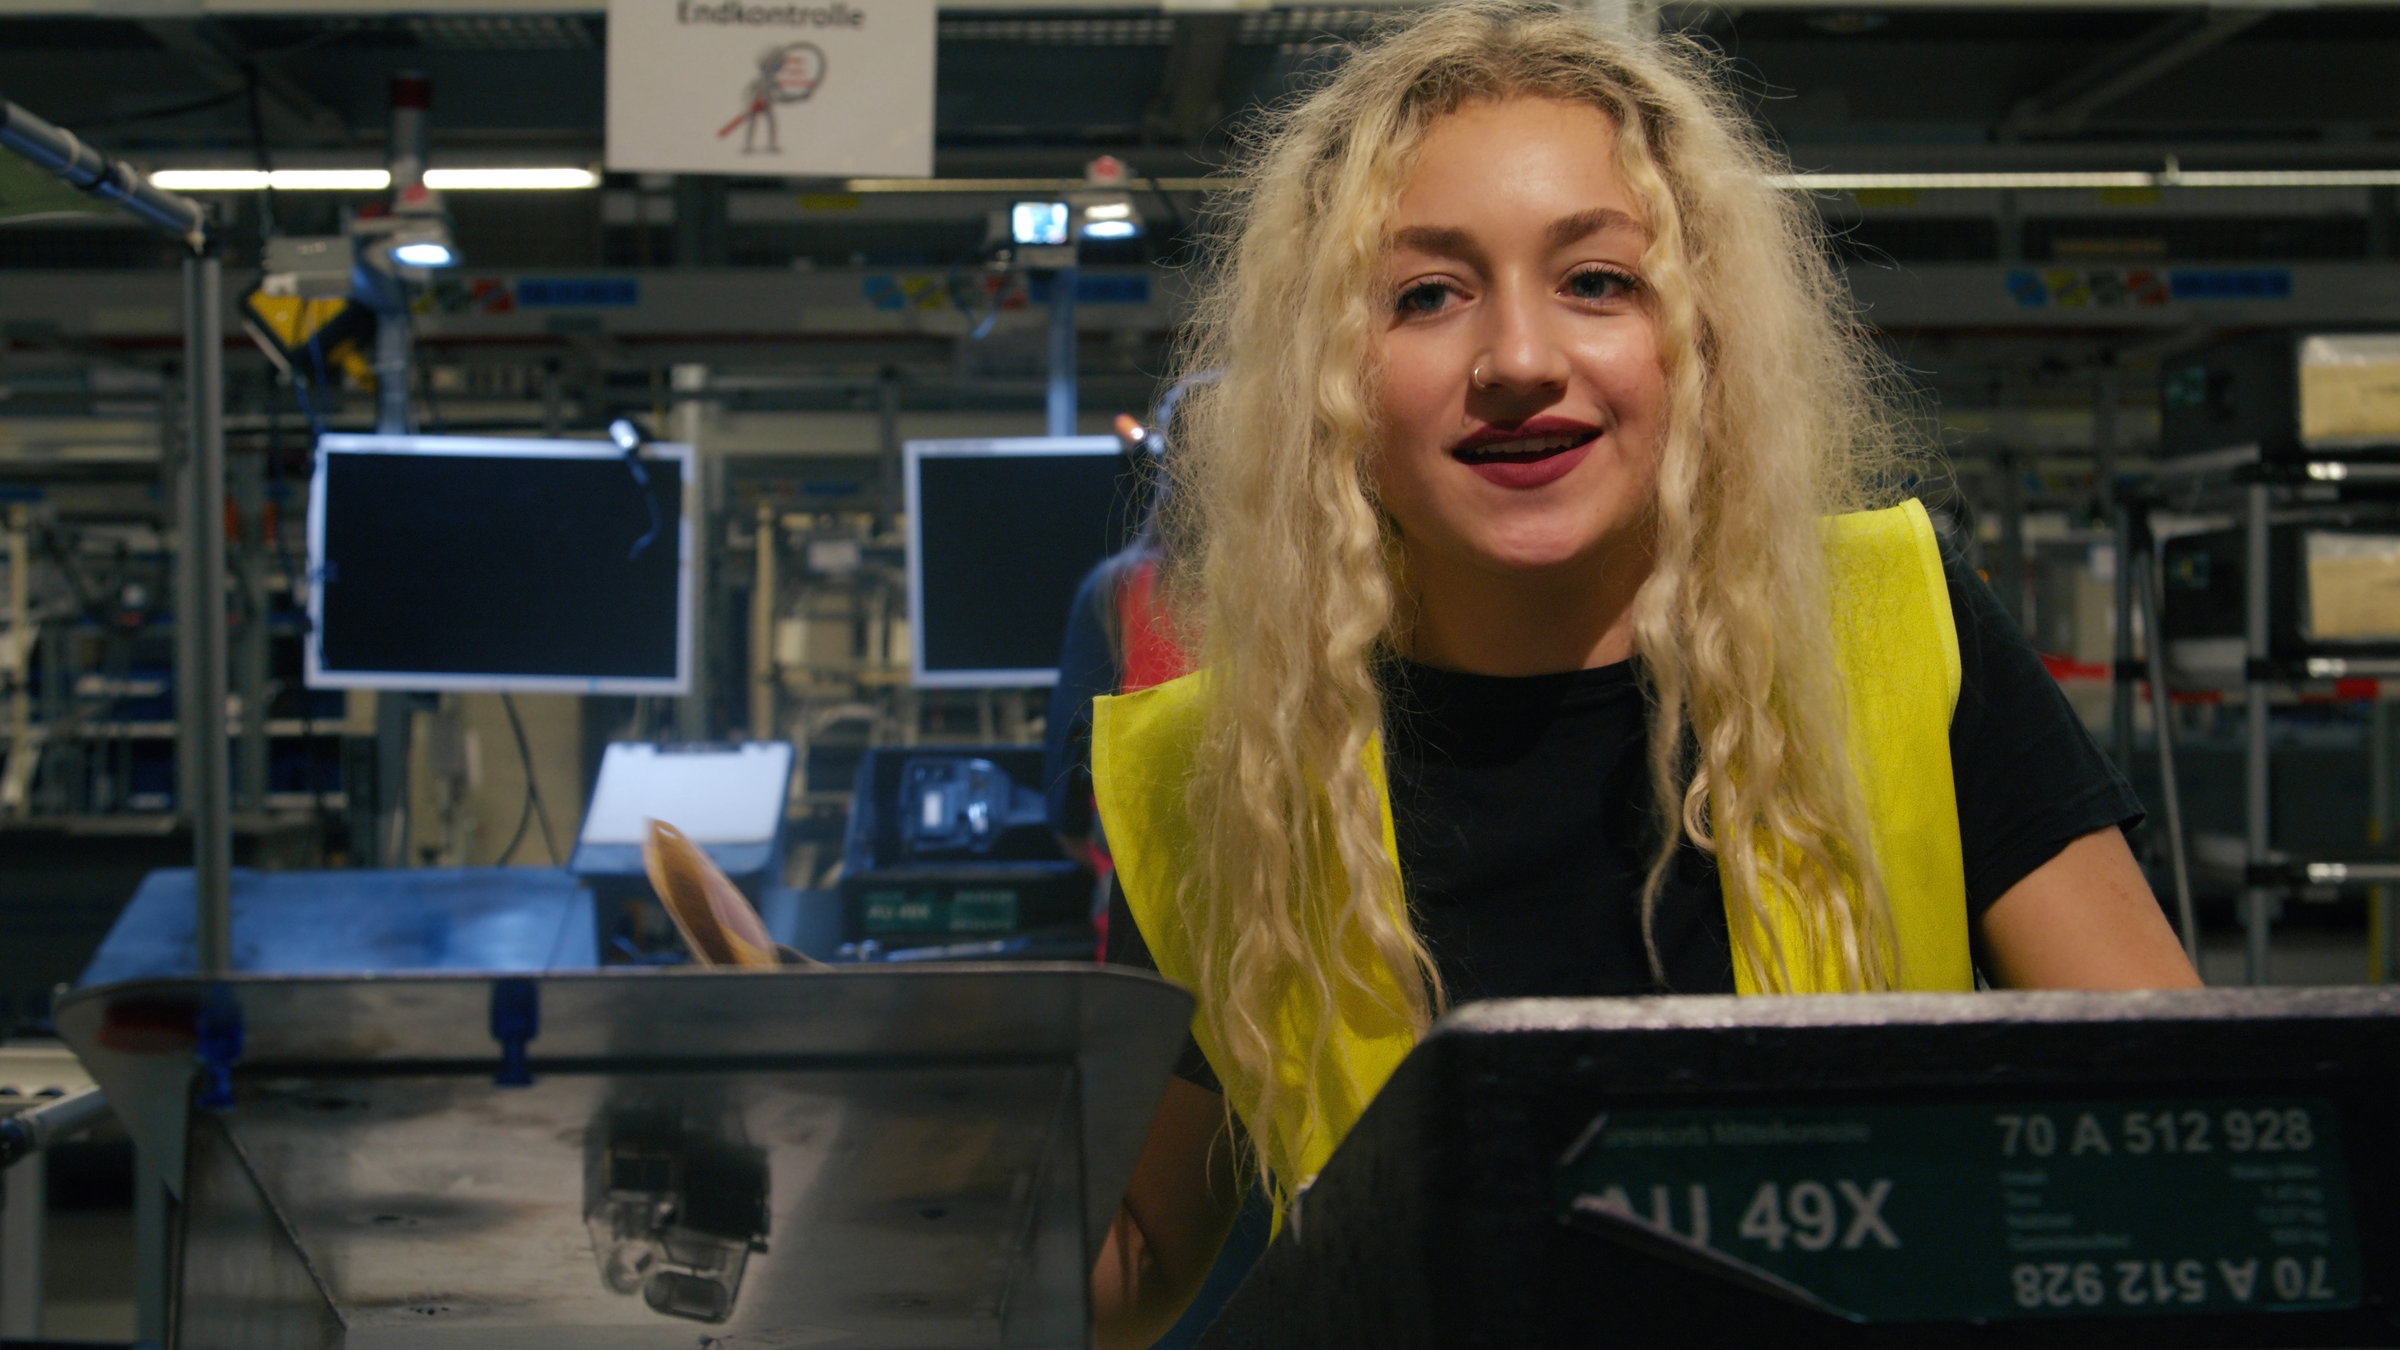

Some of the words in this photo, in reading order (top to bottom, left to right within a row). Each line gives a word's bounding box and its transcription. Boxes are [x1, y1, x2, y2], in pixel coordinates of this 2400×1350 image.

[677, 0, 864, 27] Endkontrolle
[1994, 1113, 2057, 1157] 70
[2071, 1112, 2112, 1156] A
[2122, 1110, 2215, 1154] 512
[2221, 1108, 2317, 1152] 928
[1736, 1177, 1903, 1252] 49X
[2010, 1261, 2105, 1308] 928
[2114, 1258, 2208, 1305] 512
[2216, 1256, 2260, 1303] A
[2271, 1255, 2336, 1301] 70
